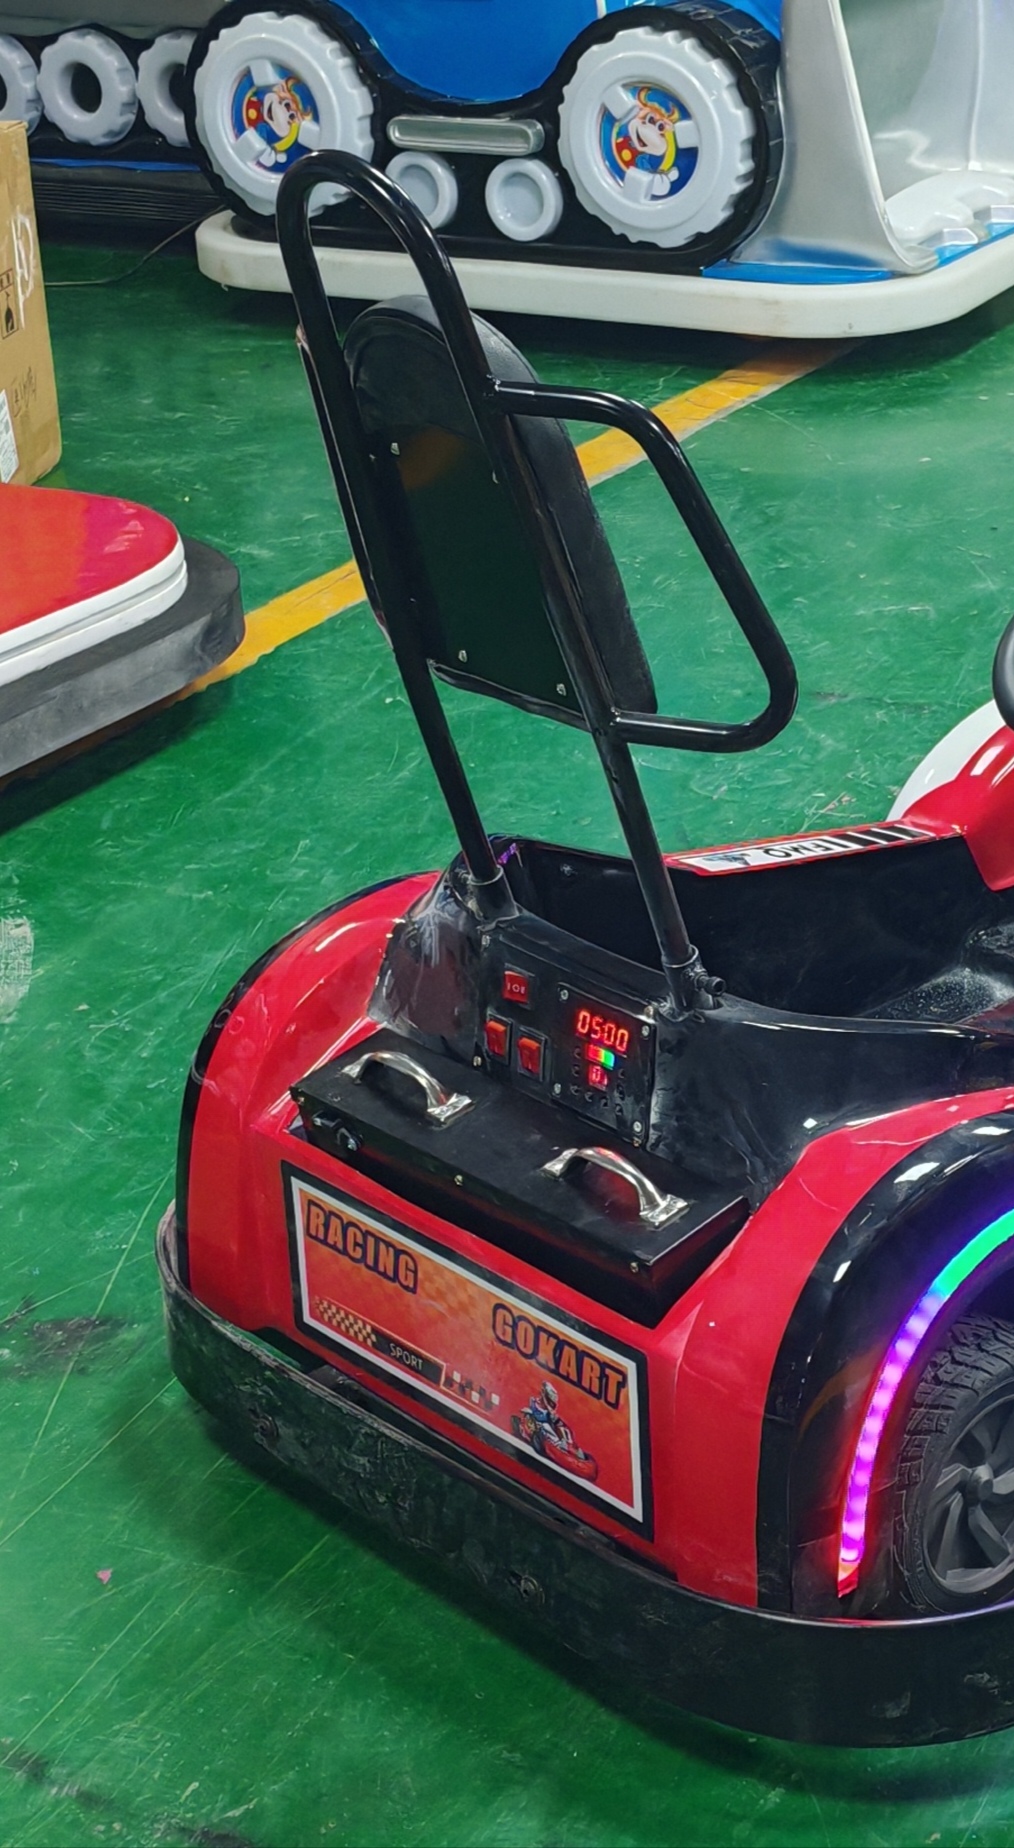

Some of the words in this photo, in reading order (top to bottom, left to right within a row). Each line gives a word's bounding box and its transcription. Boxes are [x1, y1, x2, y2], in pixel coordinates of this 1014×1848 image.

[307, 1199, 418, 1294] RACING
[389, 1342, 424, 1371] SPORT
[492, 1302, 627, 1410] GOKART
